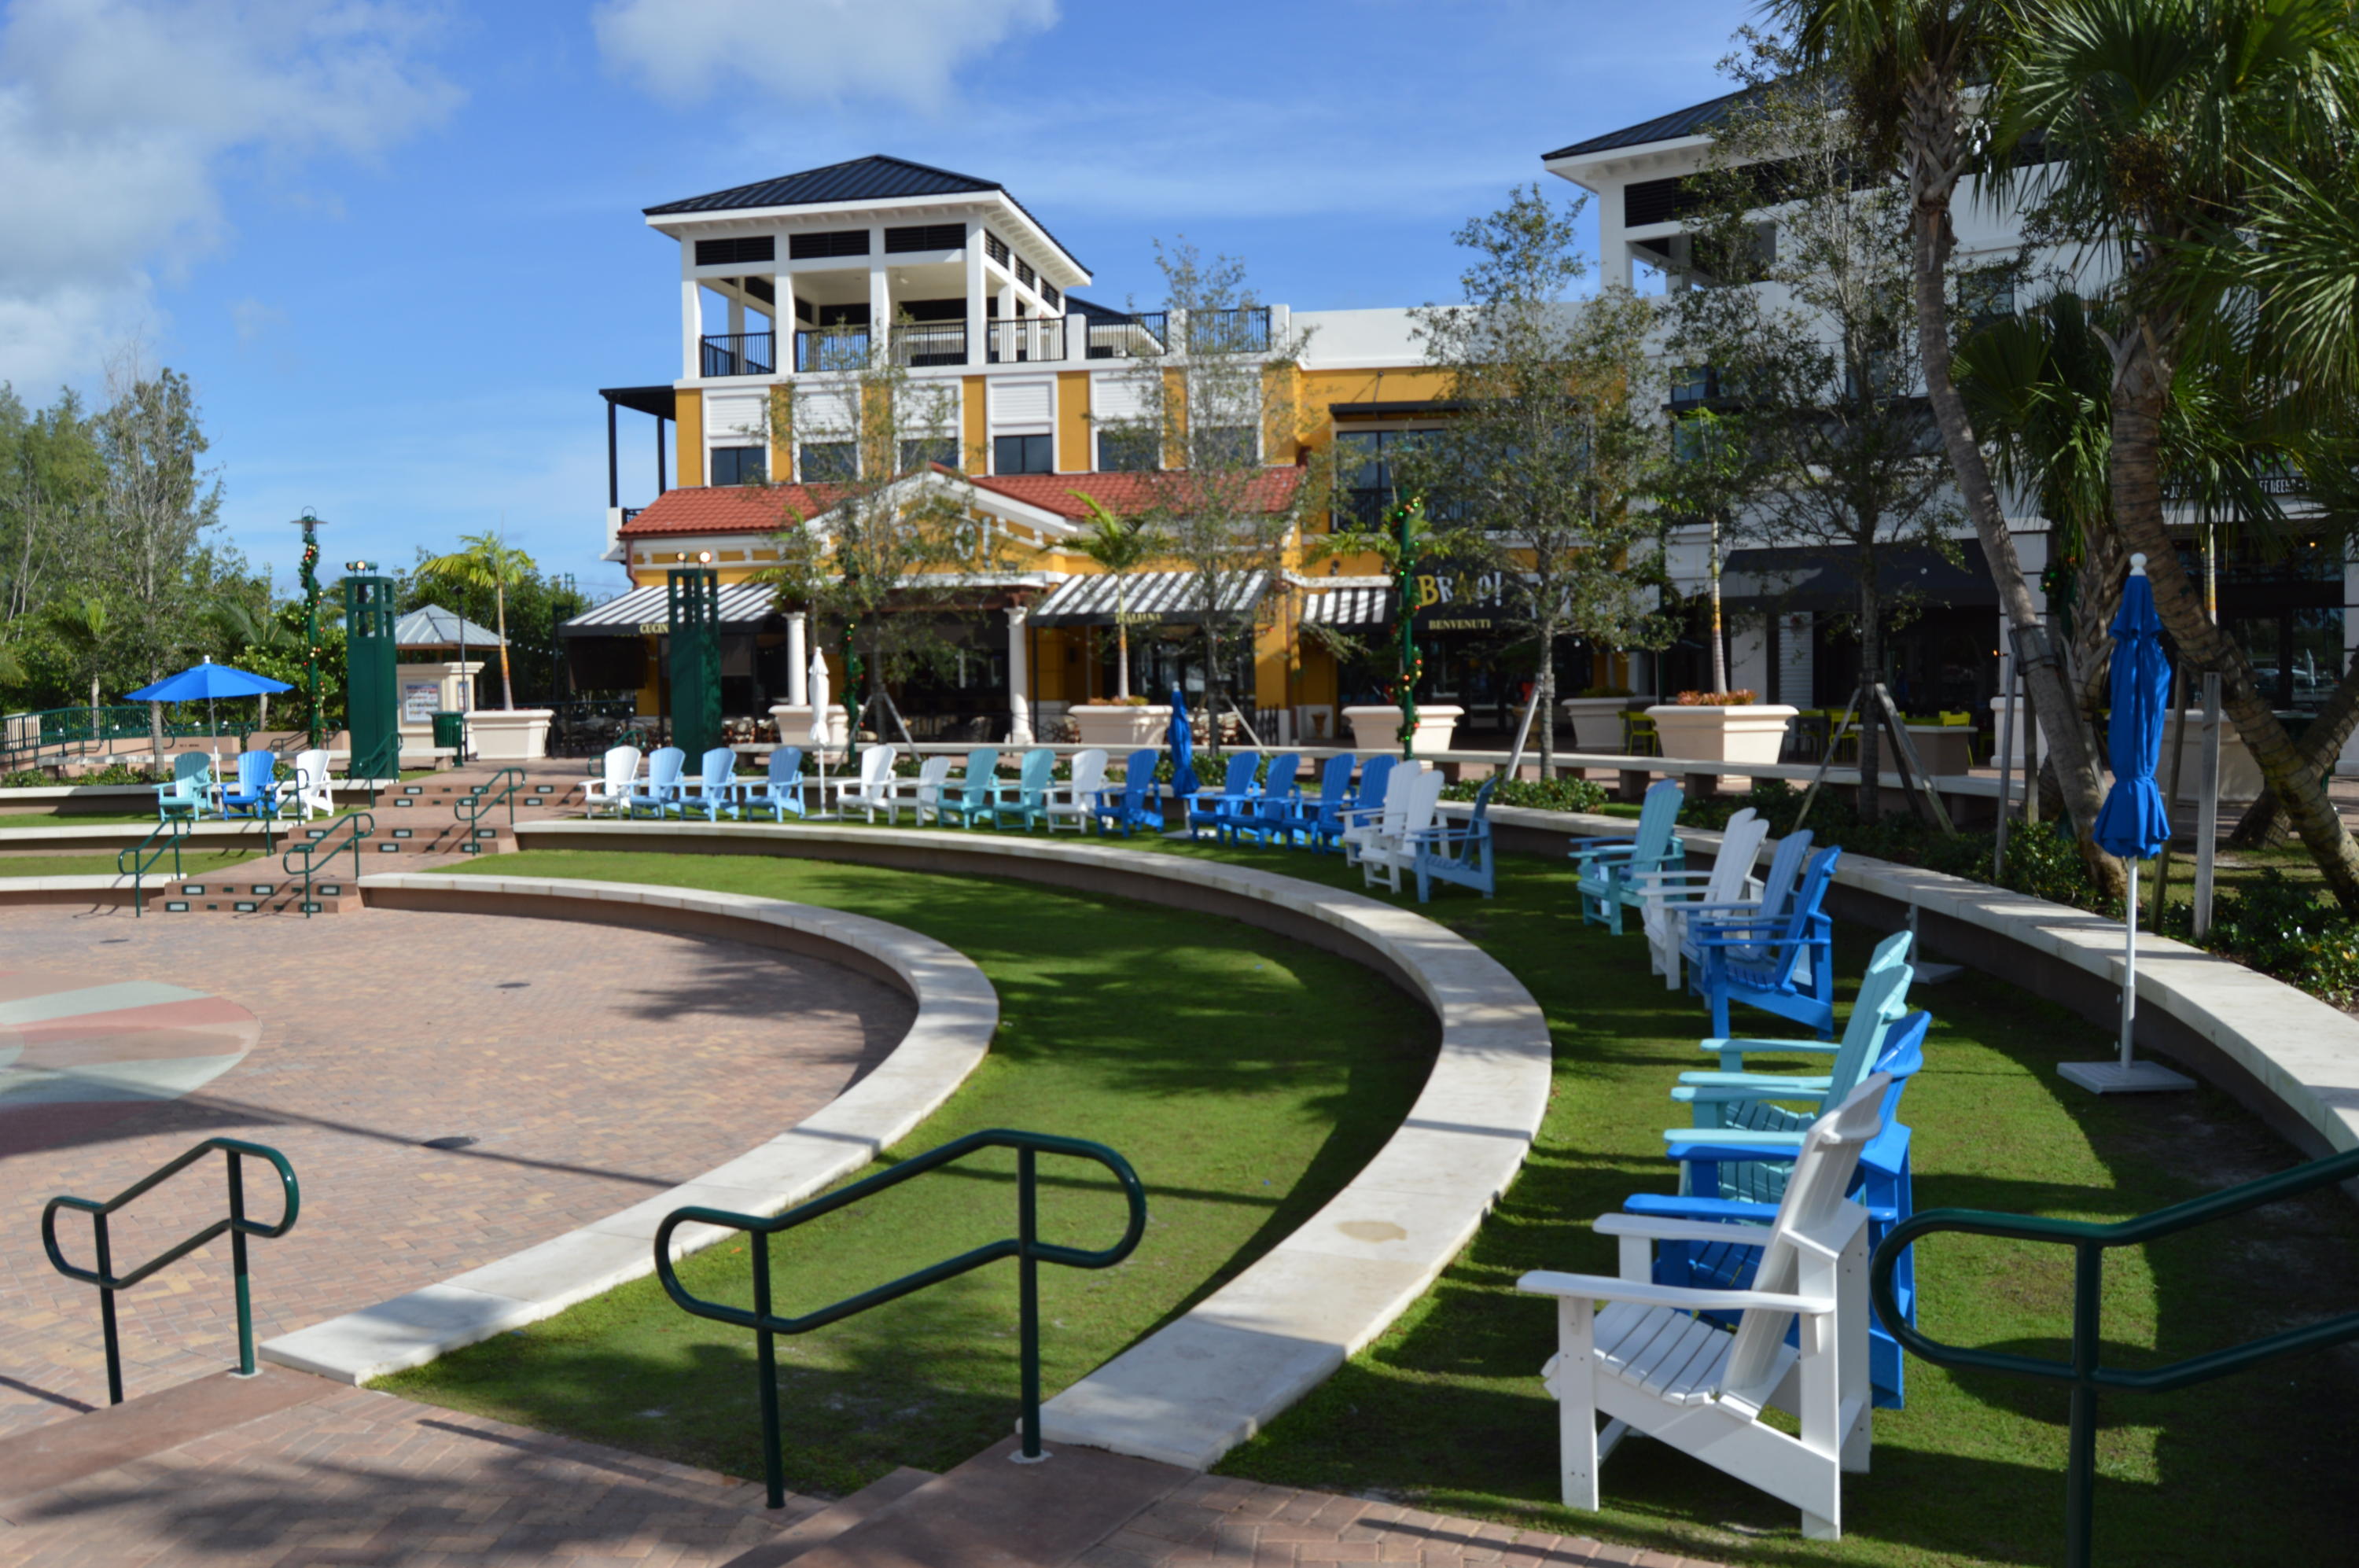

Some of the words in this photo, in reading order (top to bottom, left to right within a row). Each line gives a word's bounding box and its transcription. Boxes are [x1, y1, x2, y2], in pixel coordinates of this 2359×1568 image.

[1417, 571, 1502, 608] BRAO!
[639, 623, 669, 634] CUCIN
[1429, 619, 1491, 630] BENVENUTI
